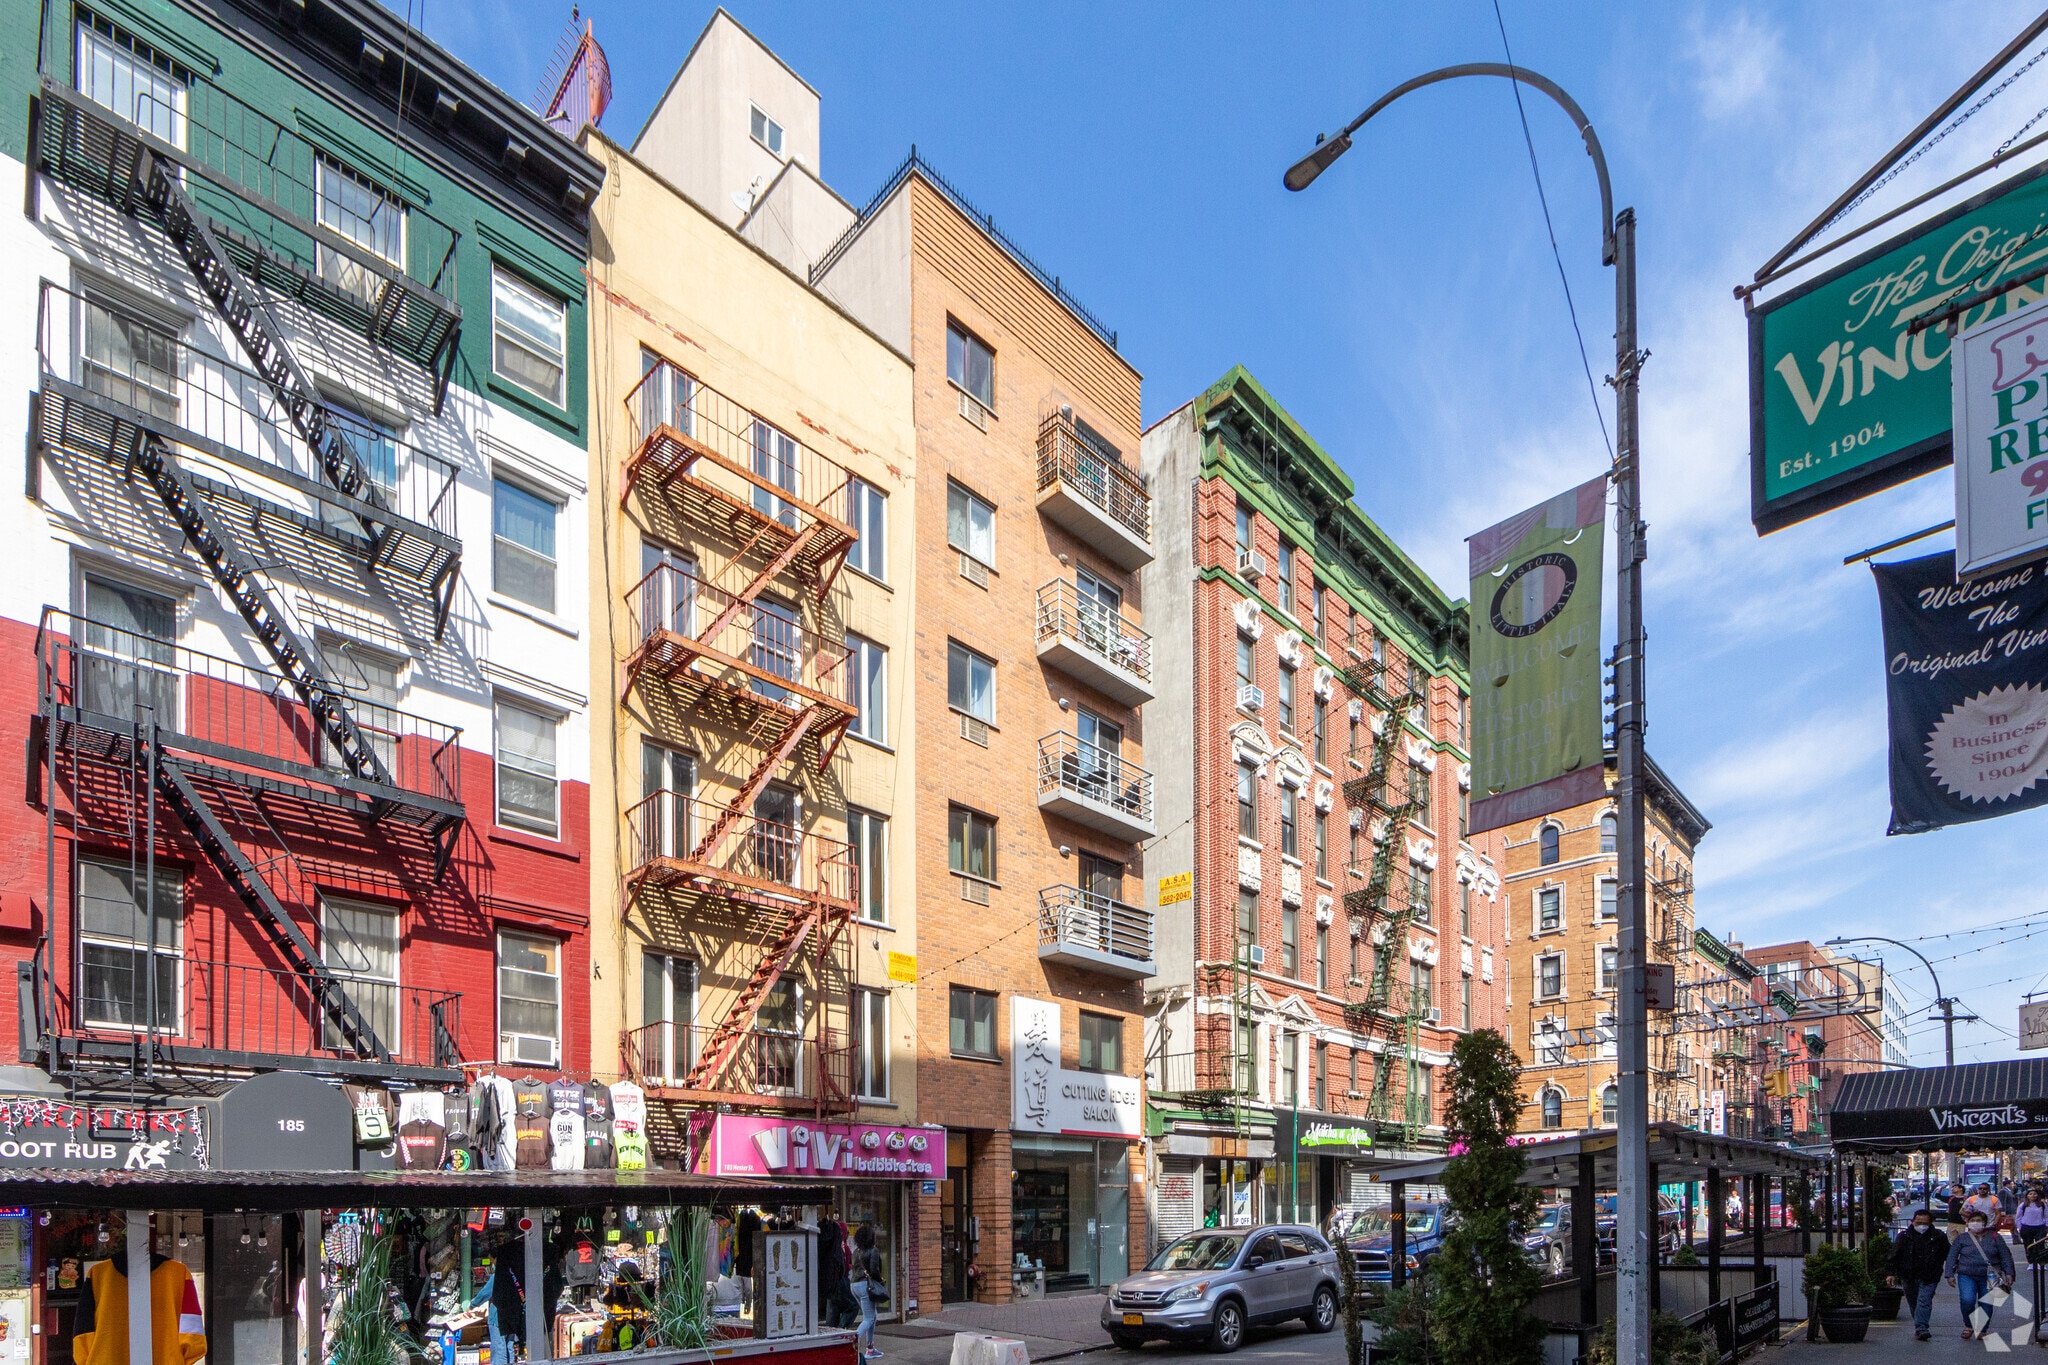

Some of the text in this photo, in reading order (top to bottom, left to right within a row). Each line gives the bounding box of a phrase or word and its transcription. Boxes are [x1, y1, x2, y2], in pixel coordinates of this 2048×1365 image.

[1845, 255, 1929, 333] The
[1779, 421, 1887, 479] Est. 1904
[1502, 555, 1567, 590] HISTORIC
[1918, 566, 2034, 610] Welcome
[1492, 579, 1576, 638] LITTLE ITALY
[1968, 600, 2020, 632] The
[1473, 620, 1592, 687] WELCOME
[1889, 638, 1993, 681] Original
[1475, 688, 1502, 713] TO
[1475, 679, 1585, 738] HISTORIC
[1952, 718, 2048, 750] Business
[1988, 713, 2009, 728] In
[1475, 722, 1556, 767] LITTLE
[1971, 742, 2030, 766] Since
[1475, 754, 1545, 793] ITALY
[1978, 761, 2028, 783] 1904
[1062, 1083, 1137, 1106] CUTTING EDGE
[277, 1119, 305, 1132] 185
[557, 1124, 573, 1132] GUN
[1083, 1105, 1117, 1123] SALON
[64, 1142, 117, 1159] RUB
[749, 1125, 854, 1171] ViVi
[854, 1156, 932, 1174] bubble tea
